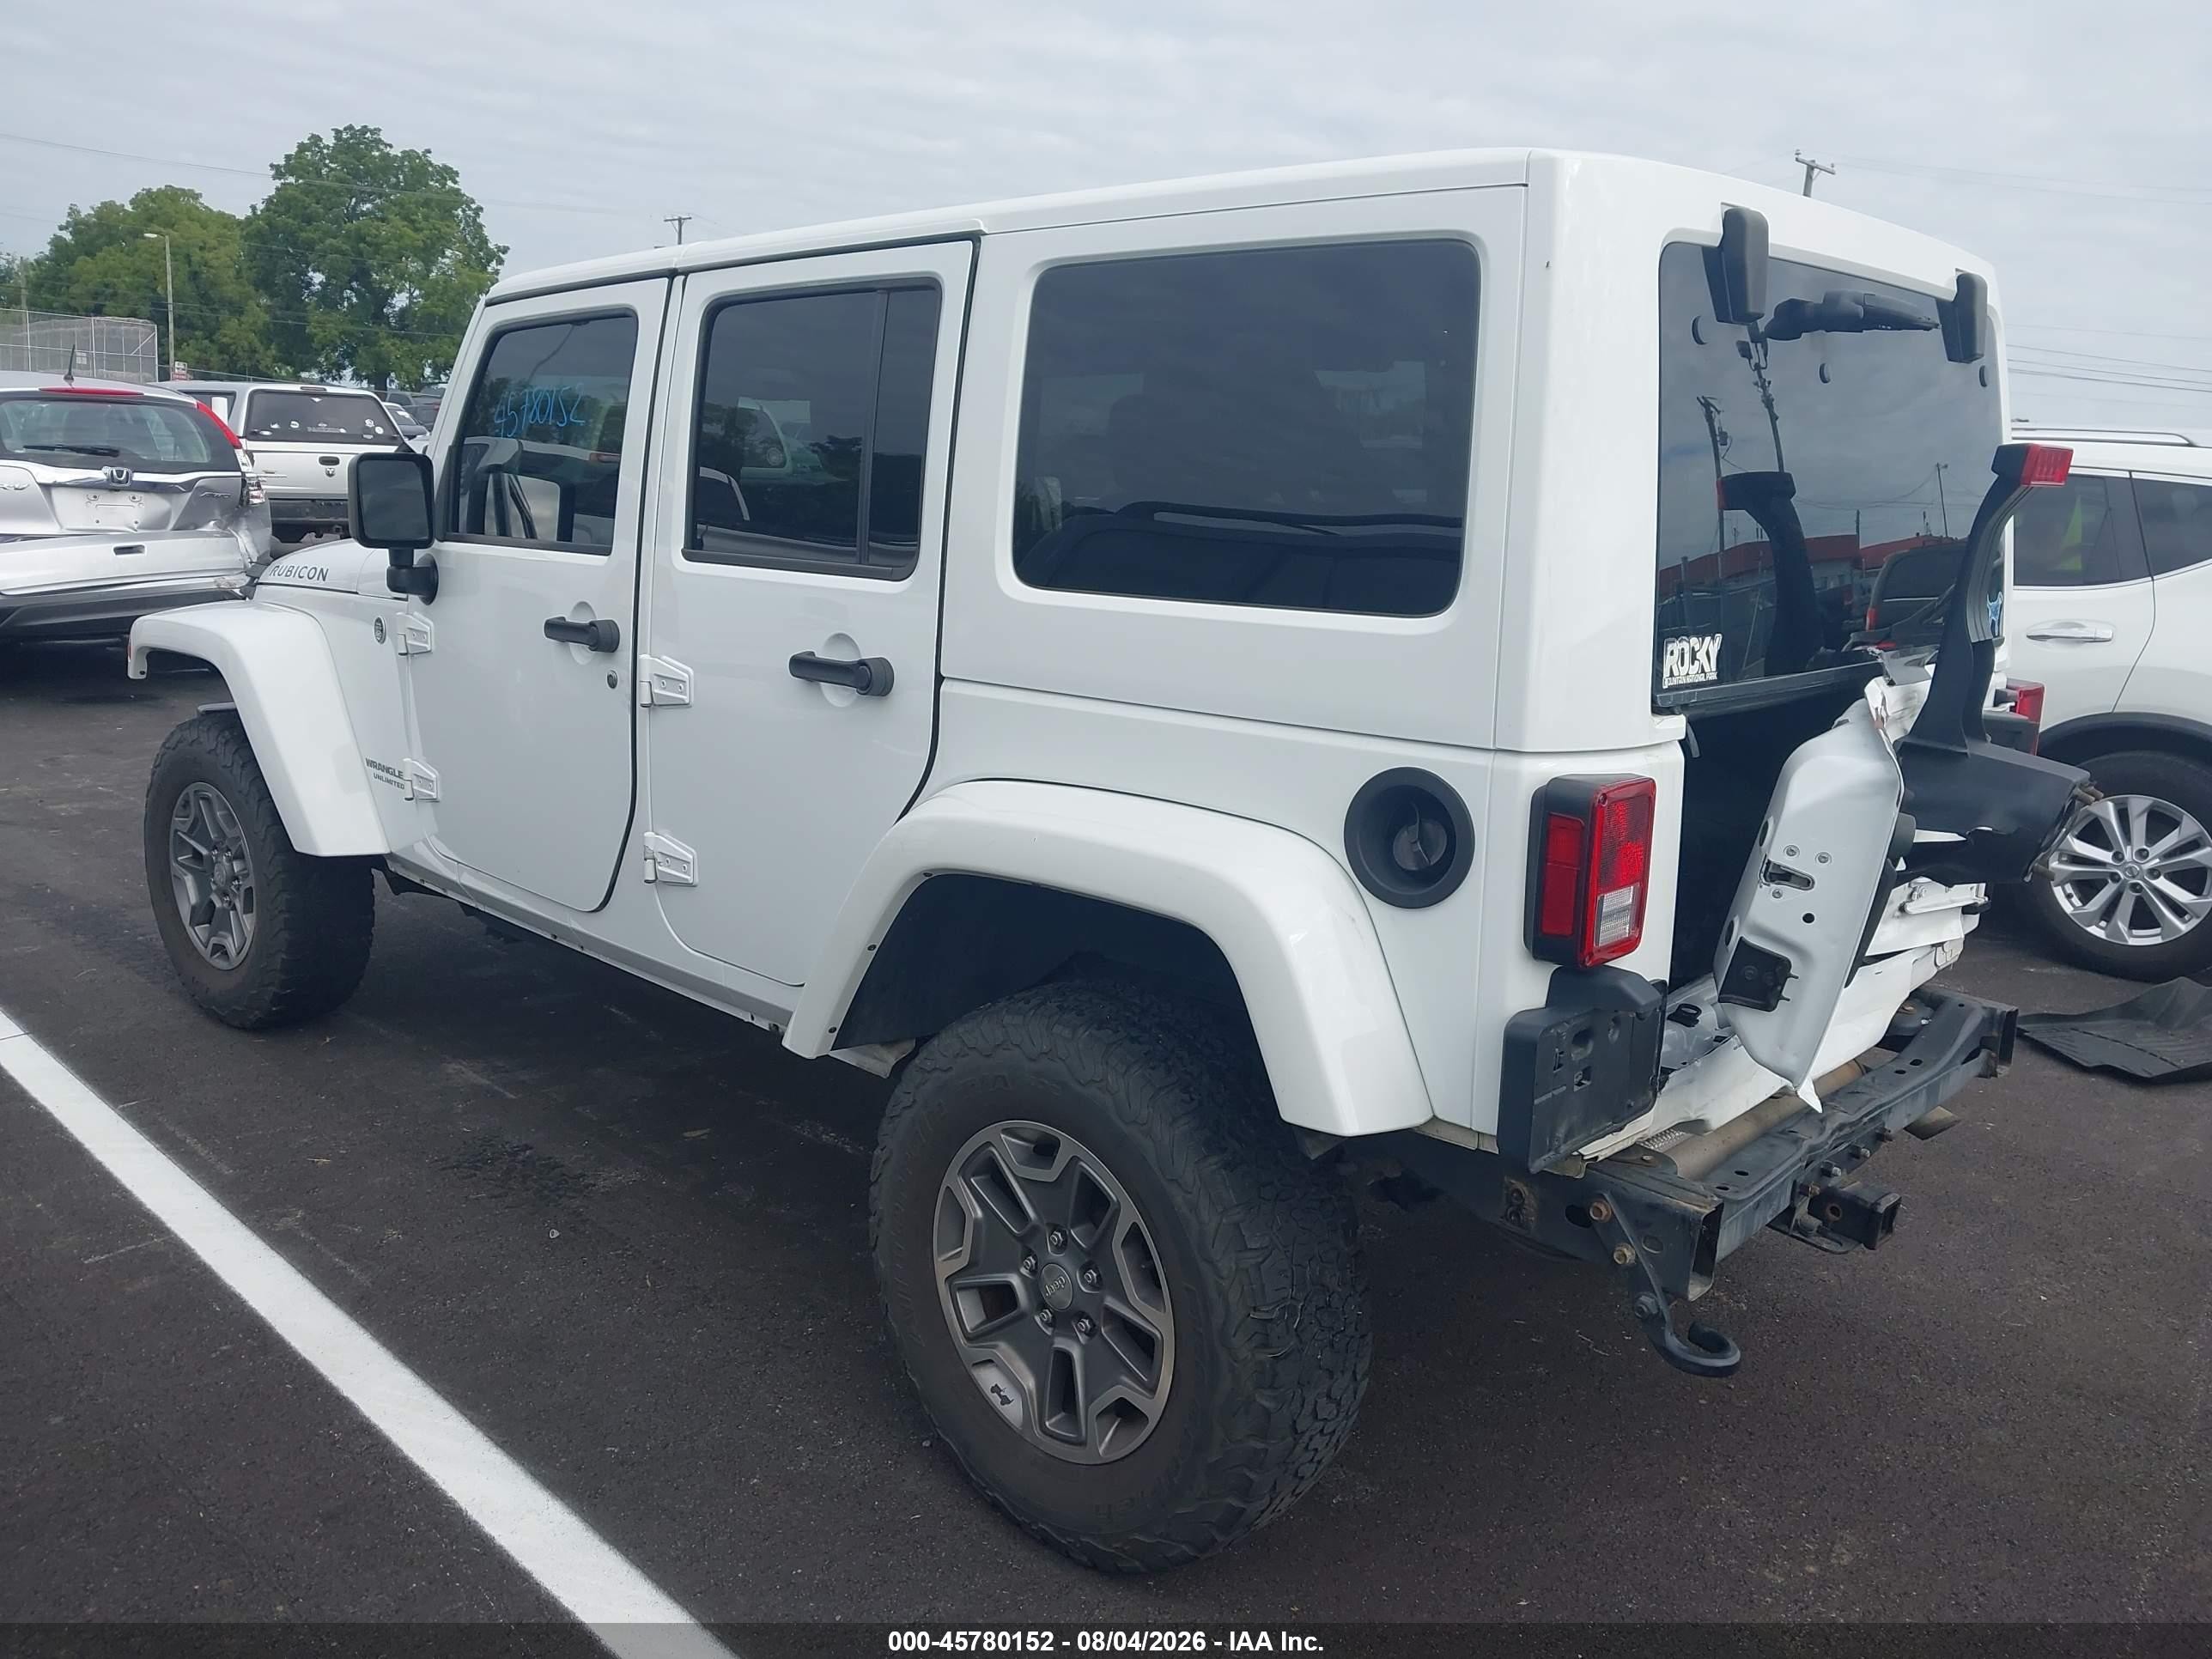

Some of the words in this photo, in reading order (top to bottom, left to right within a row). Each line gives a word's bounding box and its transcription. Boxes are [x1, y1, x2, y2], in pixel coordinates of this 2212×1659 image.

[494, 383, 586, 439] 45780152
[269, 564, 330, 582] RUBICON
[1663, 633, 1723, 678] ROCKY
[365, 757, 404, 778] WRANGLE
[373, 772, 405, 790] UNLIMITED
